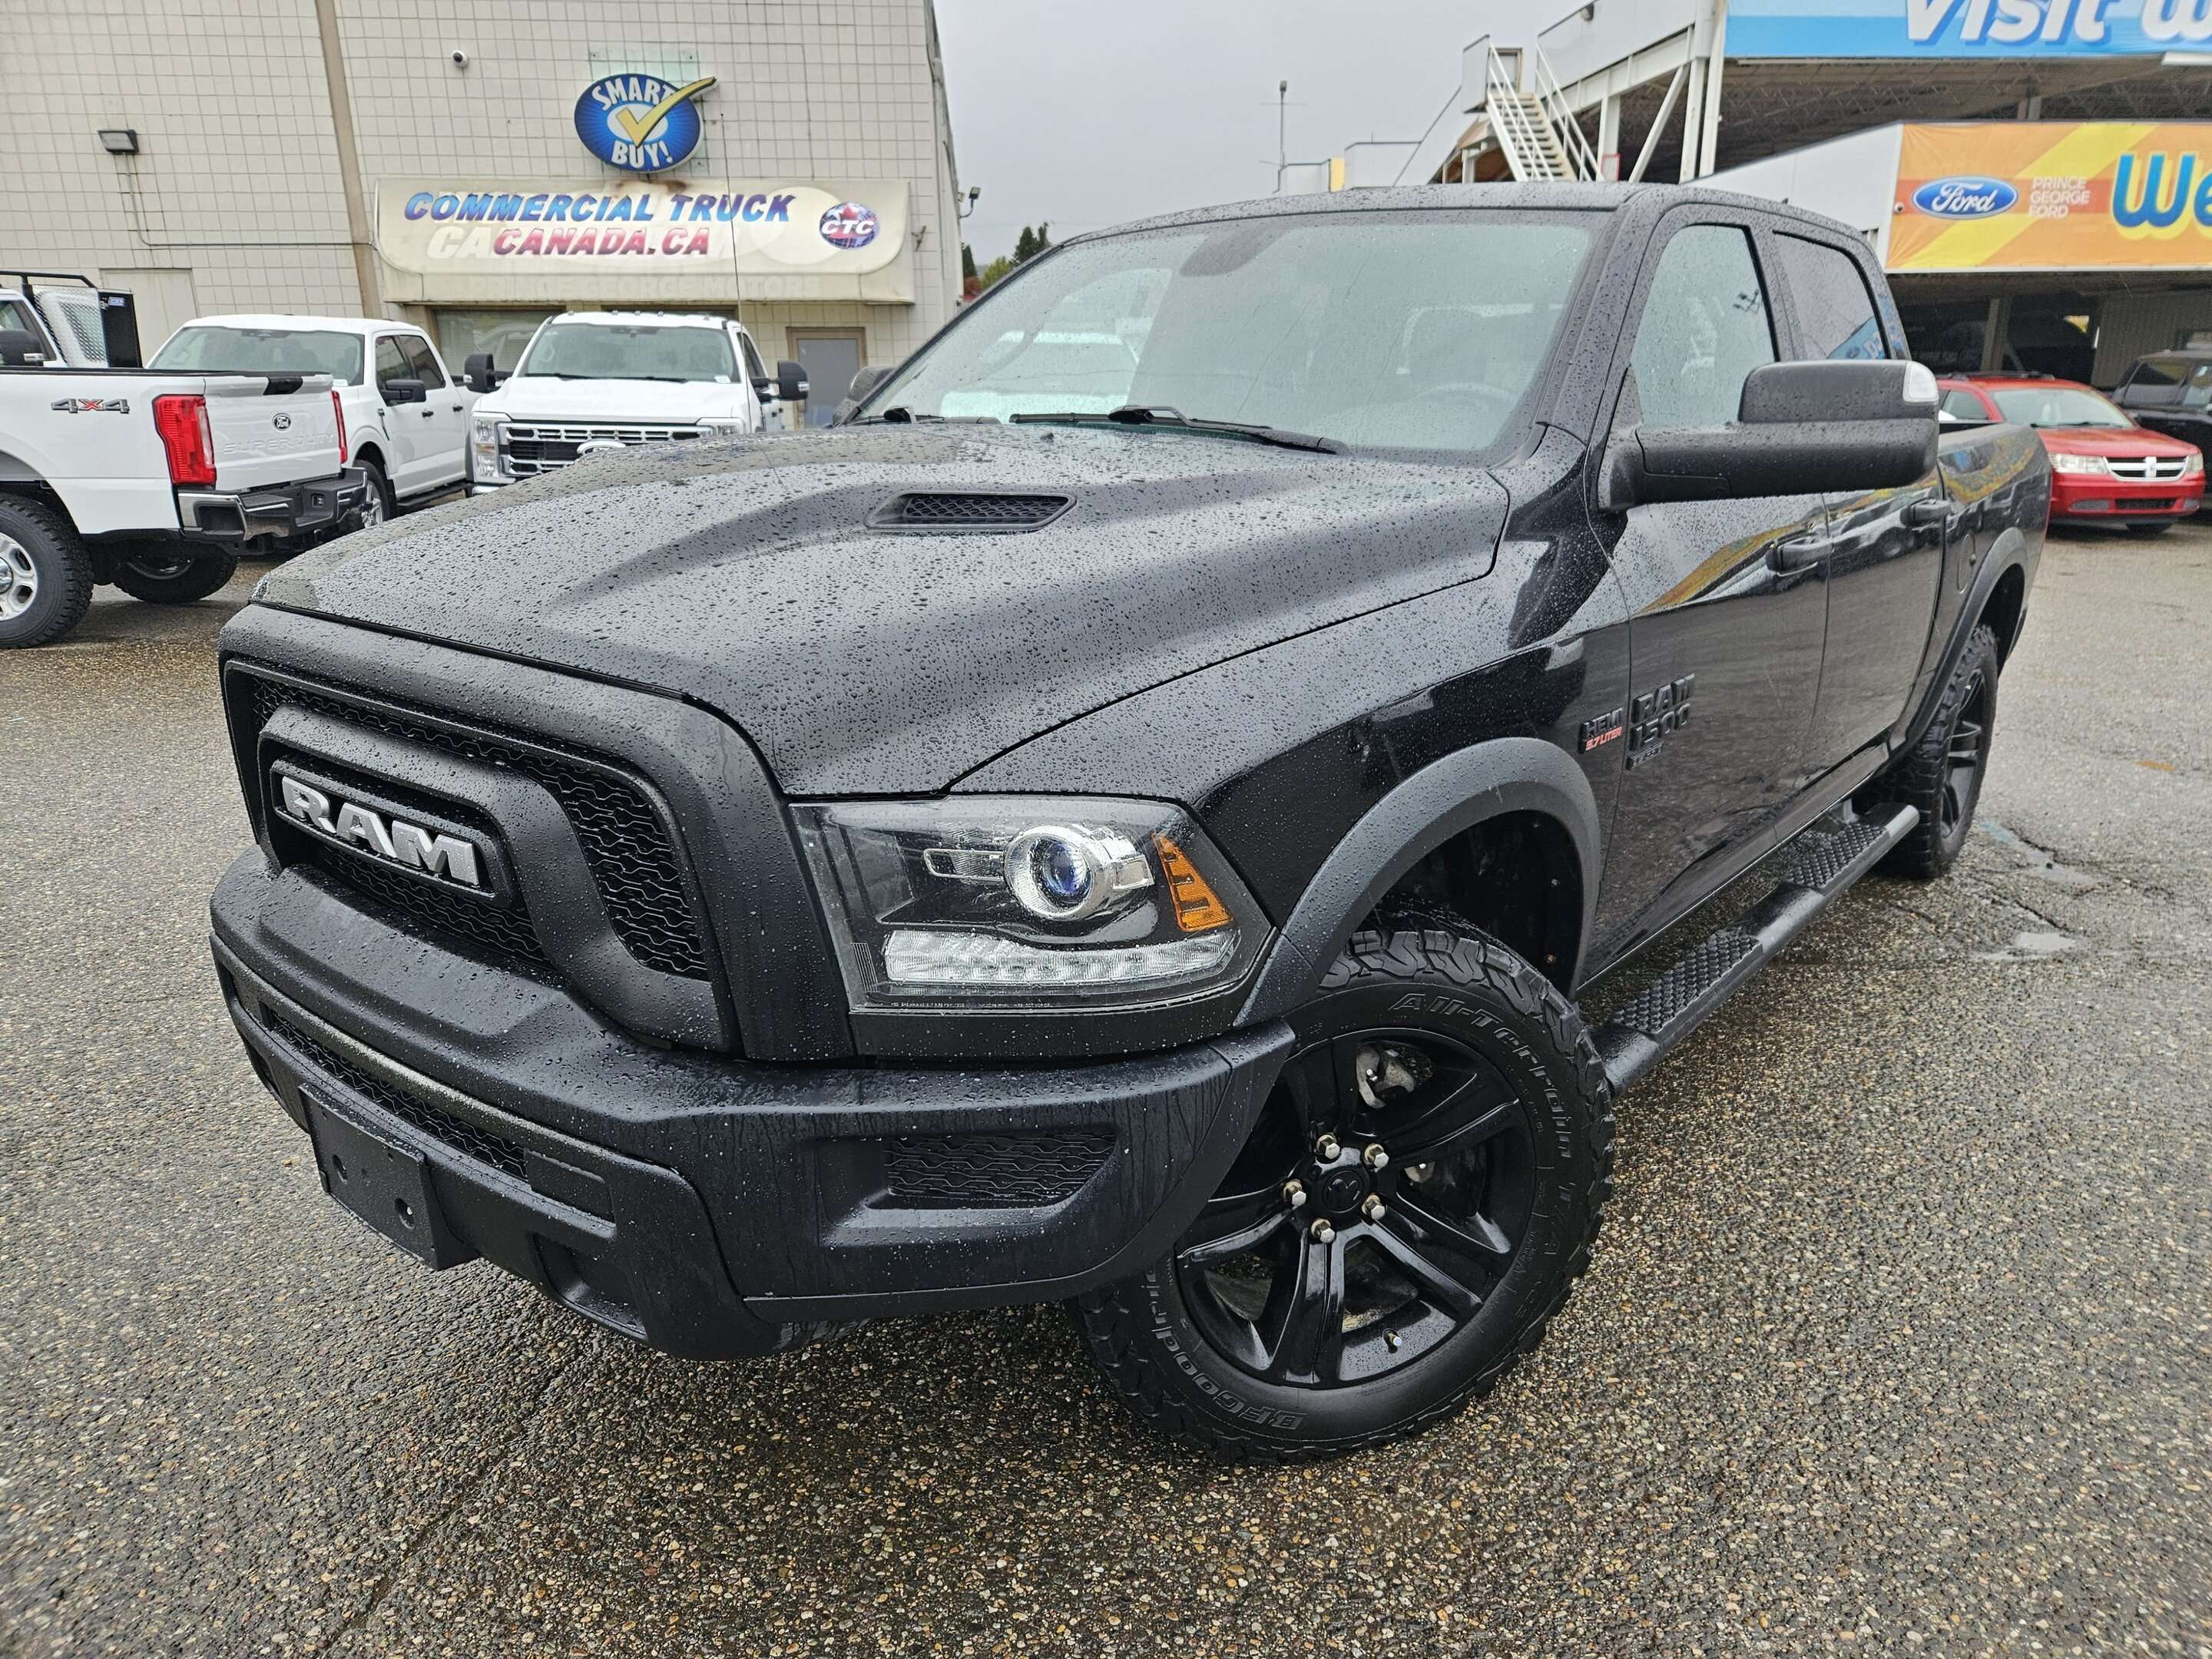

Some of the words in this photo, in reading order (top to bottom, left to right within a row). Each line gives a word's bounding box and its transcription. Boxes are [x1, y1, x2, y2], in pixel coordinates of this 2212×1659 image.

[591, 77, 677, 111] SMART
[611, 140, 673, 168] BUY!
[1931, 181, 1999, 213] Ford
[2030, 190, 2090, 204] GEORGE
[2032, 177, 2087, 190] PRINCE
[404, 192, 654, 222] COMMERCIAL
[670, 194, 796, 222] TRUCK
[2028, 204, 2068, 218] FORD
[493, 227, 710, 255] CANADA.CA
[820, 220, 875, 235] CTC
[224, 437, 296, 455] SUPER
[1631, 673, 1695, 724] RAM
[1581, 707, 1623, 739] HEMI
[1628, 702, 1690, 751] 1500
[282, 776, 479, 885] RAM
[1141, 1267, 1307, 1430] BFGoodric
